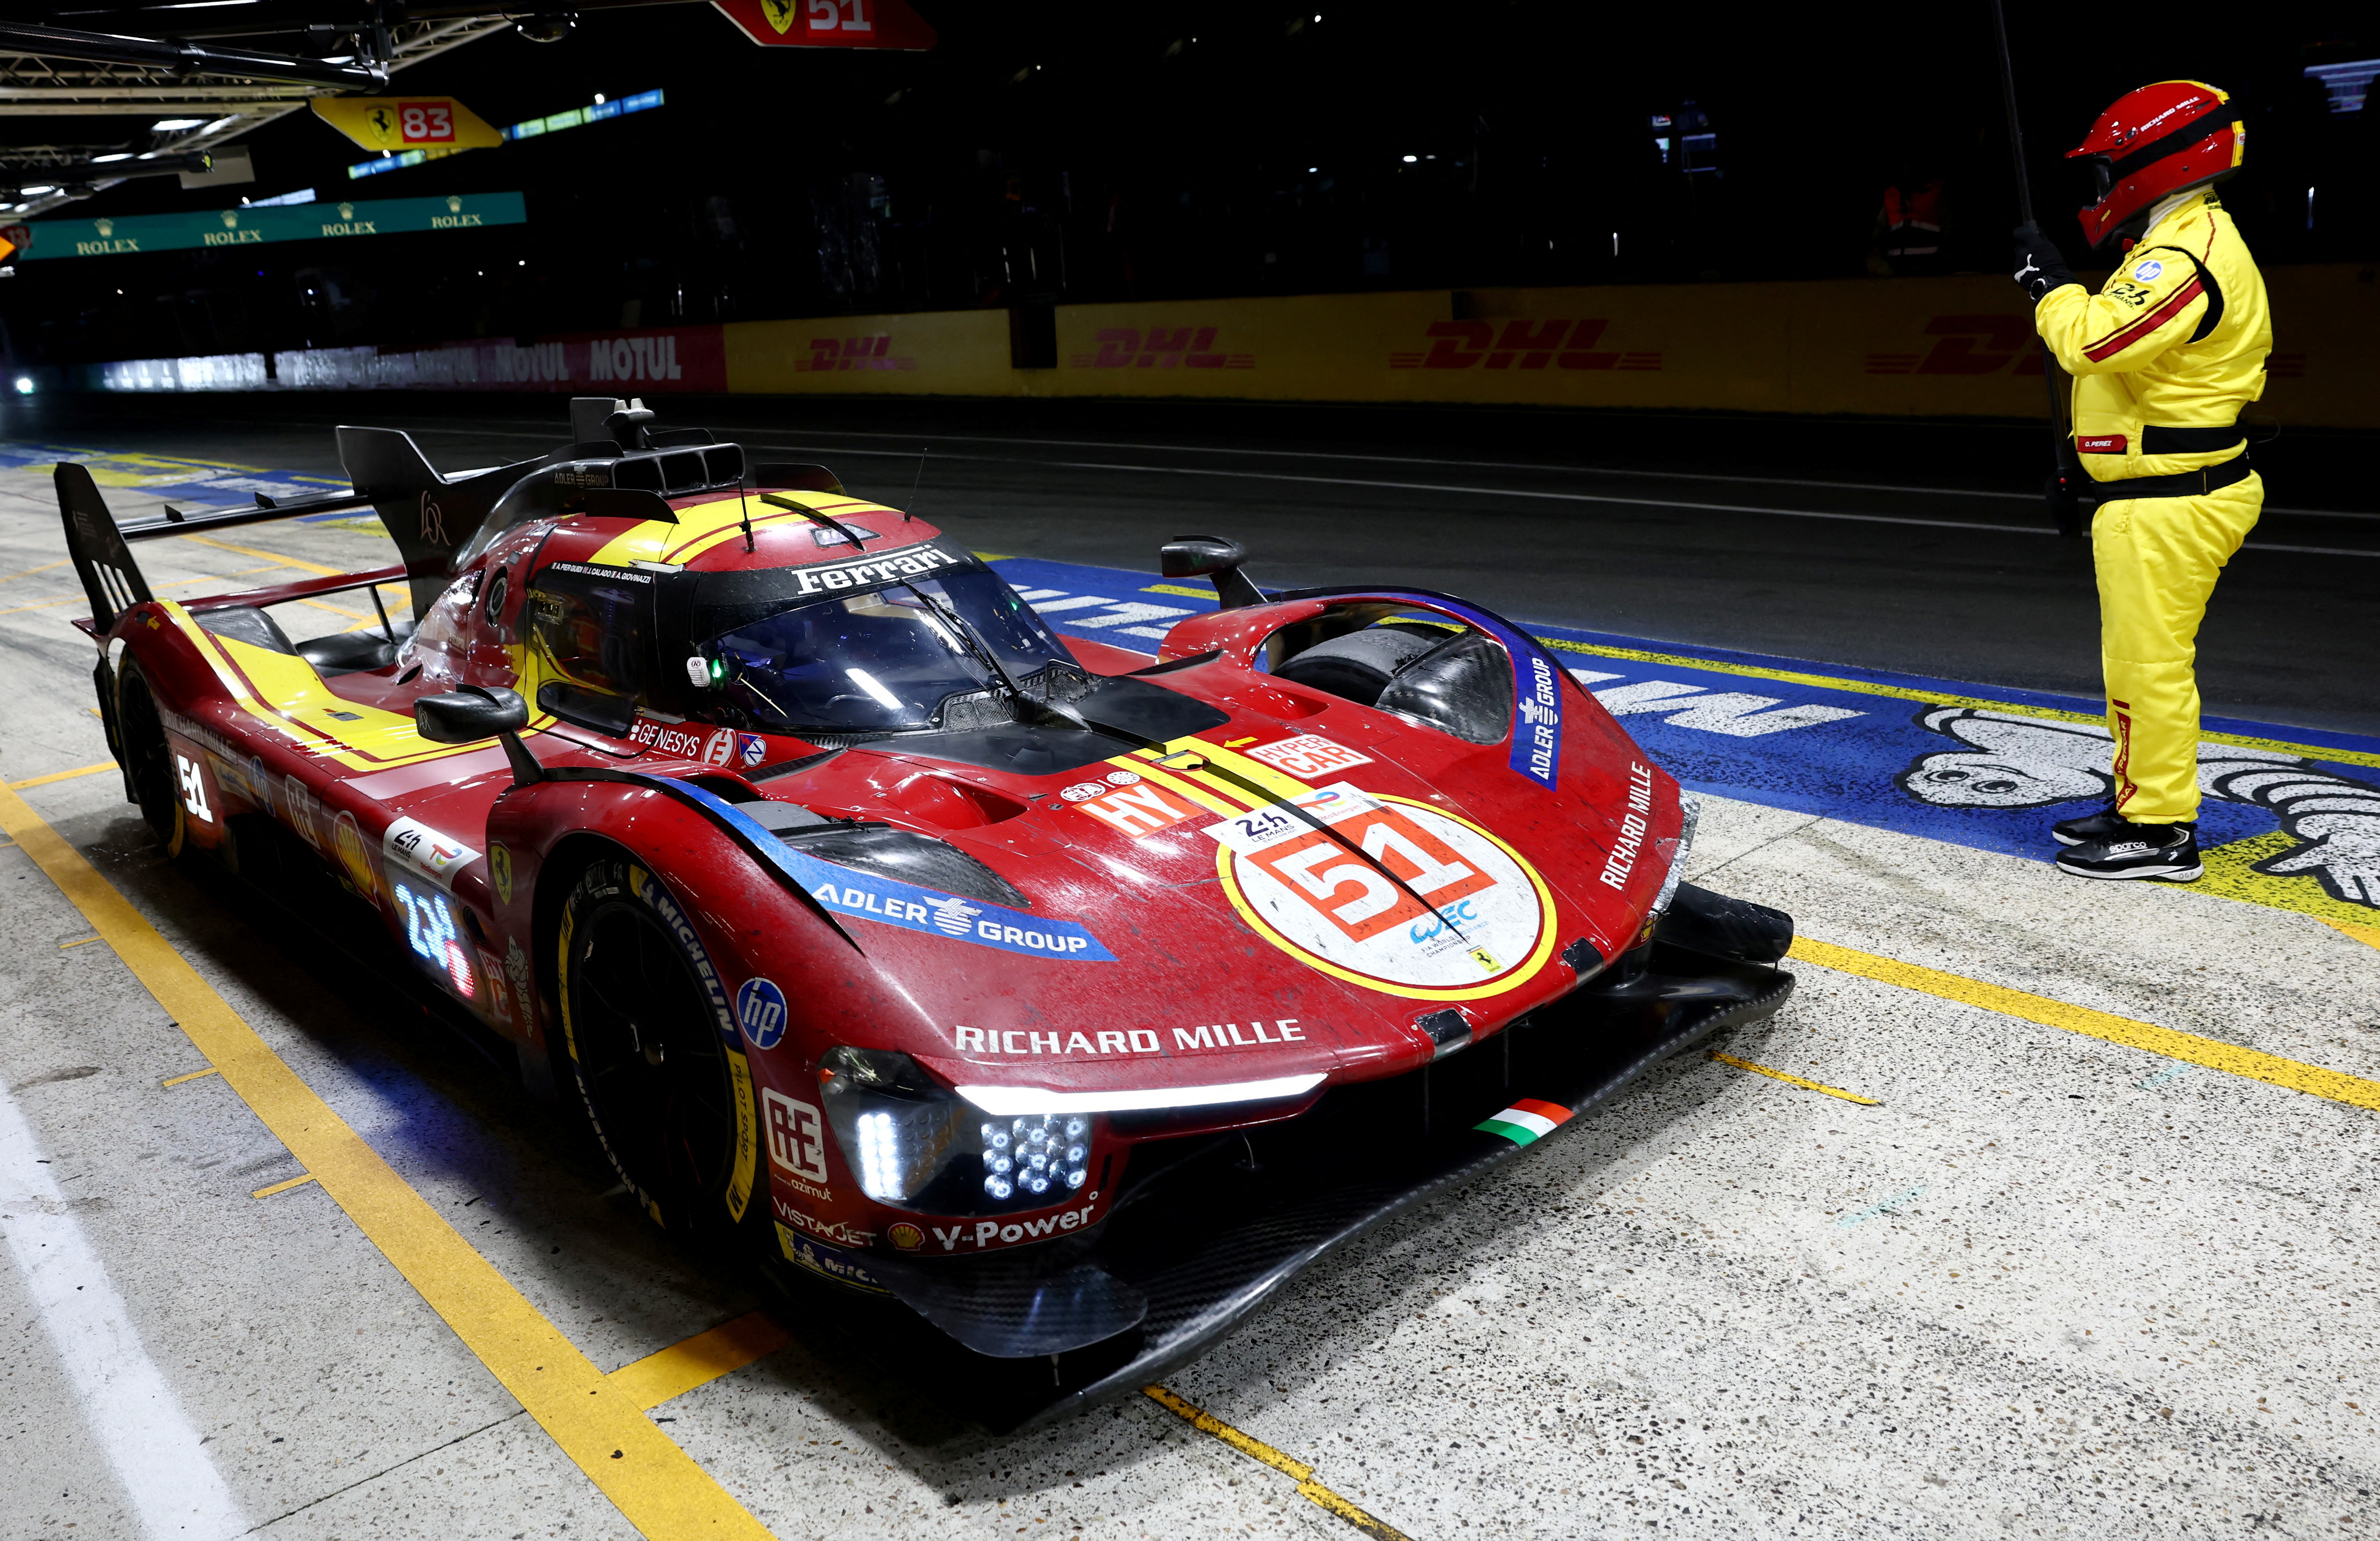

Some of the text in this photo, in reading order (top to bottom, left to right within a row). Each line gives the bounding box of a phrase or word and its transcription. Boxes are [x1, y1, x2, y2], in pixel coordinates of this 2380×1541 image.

[809, 0, 871, 31] 51
[403, 107, 452, 138] 83
[2140, 96, 2200, 132] RICHARD MILLE
[203, 230, 262, 246] ROLEX
[322, 221, 376, 236] ROLEX
[431, 214, 482, 229] ROLEX
[76, 239, 140, 255] ROLEX
[2136, 261, 2161, 282] hp
[590, 336, 682, 381] MOTUL
[810, 336, 896, 371] DHL
[1094, 327, 1227, 369] DHL
[1423, 319, 1619, 370] DHL
[554, 472, 609, 486] ADLER GROUP
[591, 568, 611, 577] CALADO
[621, 573, 652, 584] GIOVINAZZI
[792, 544, 958, 595] Ferrari
[1530, 657, 1554, 780] ADLER GROUP
[638, 724, 700, 757] GENESYS
[1255, 737, 1331, 759] HYPER
[1279, 746, 1364, 773] CAR
[177, 754, 213, 823] 51
[1081, 784, 1186, 837] HY
[1235, 812, 1288, 837] 24h
[1600, 761, 1652, 891] RICHARD MILLE
[1265, 824, 1294, 837] MANS
[2109, 841, 2147, 853] sparco
[398, 847, 411, 858] MANS
[1270, 822, 1475, 925] 51
[812, 883, 1088, 953] ADLER GROUP
[1432, 936, 1454, 948] WORLD
[658, 896, 734, 1032] MICHELIN
[741, 979, 784, 1049] hp
[955, 1018, 1307, 1054] RICHARD MILLE
[734, 1063, 747, 1110] PILOT
[791, 1178, 832, 1202] azimut
[773, 1196, 877, 1246] VISTAJET
[932, 1205, 1095, 1251] V-Power
